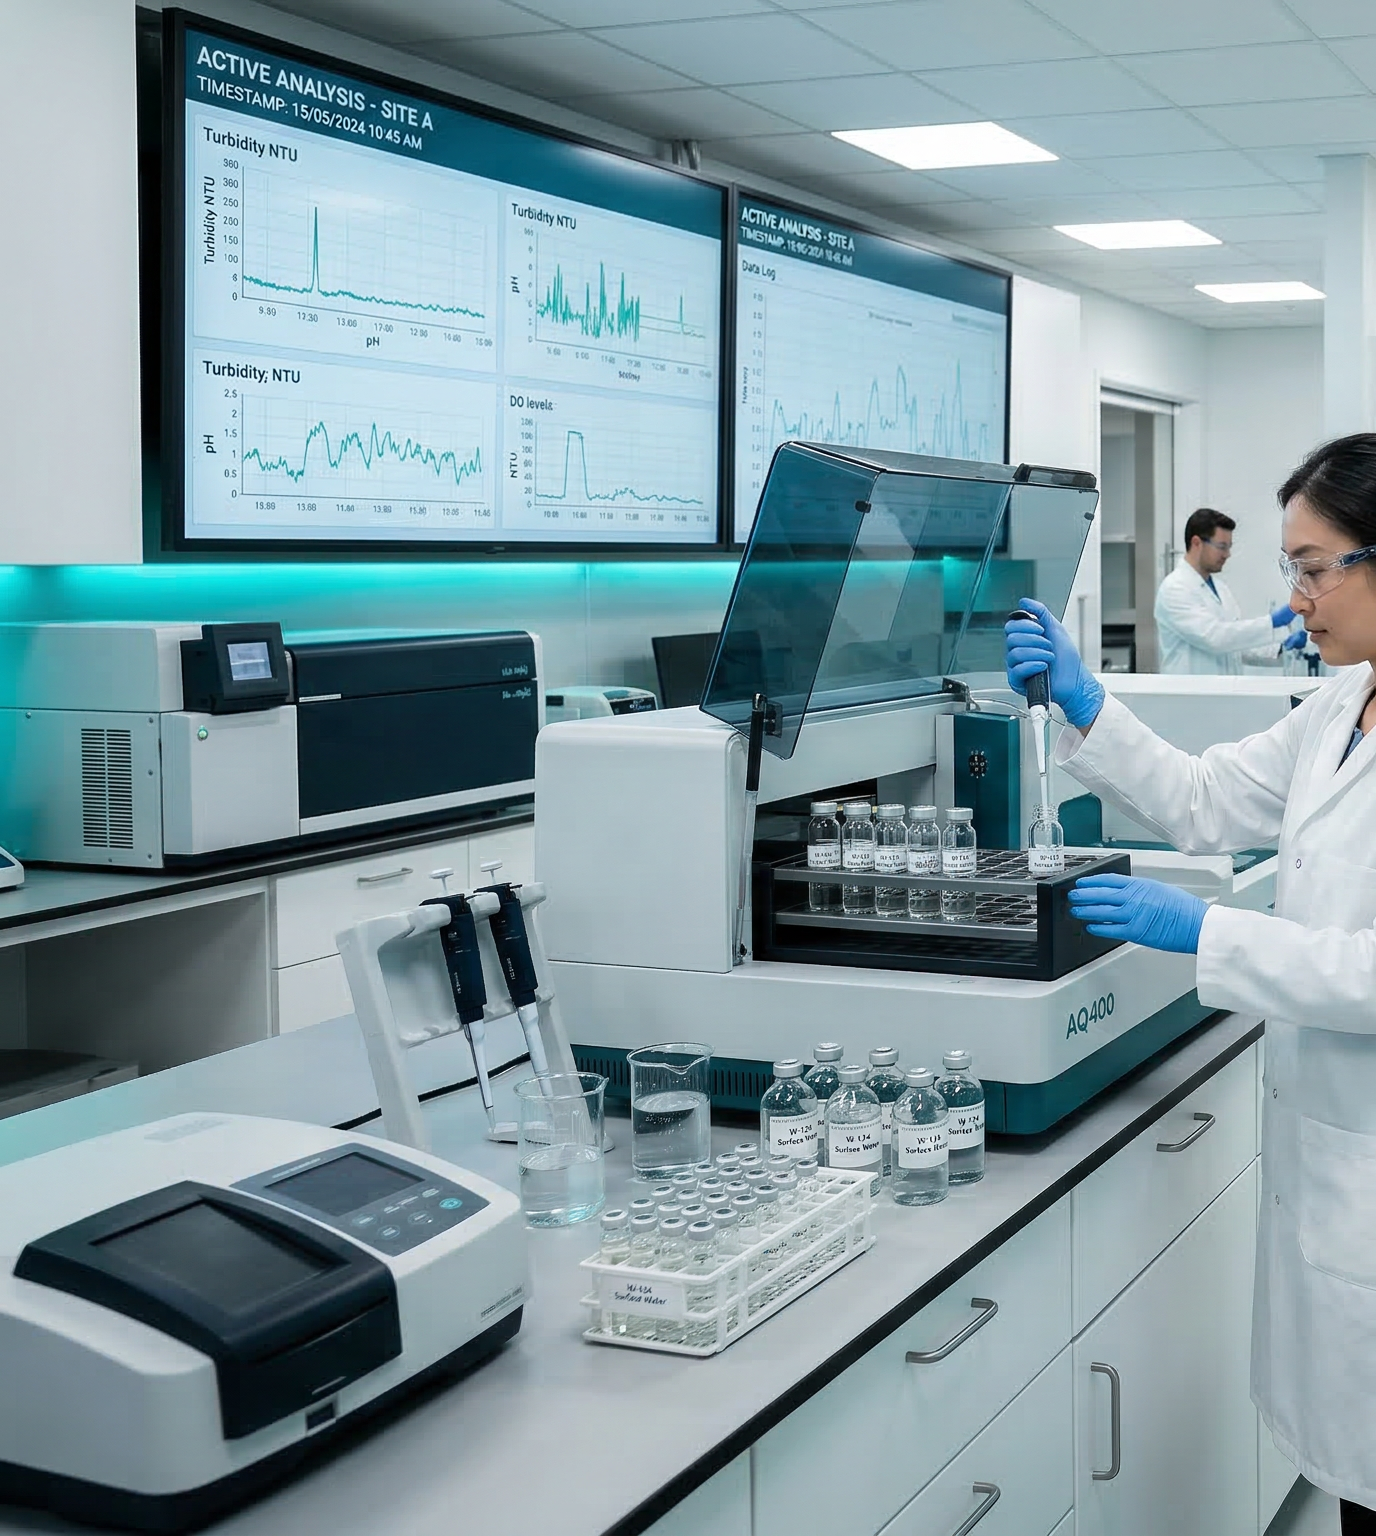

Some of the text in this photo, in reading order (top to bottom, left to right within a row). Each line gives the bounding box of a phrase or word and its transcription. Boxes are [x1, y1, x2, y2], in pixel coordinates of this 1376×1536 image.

[196, 46, 271, 85] ACTIVE
[276, 69, 366, 112] ANALYSIS
[381, 100, 418, 126] SITE
[422, 112, 433, 131] A
[196, 75, 288, 114] TIMESTAMP:
[292, 103, 366, 136] 15/05/2024
[403, 135, 423, 150] AM
[203, 127, 298, 162] Turbidity NTU
[204, 176, 215, 206] NTU
[223, 197, 239, 207] 250
[557, 214, 577, 230] NTU
[741, 207, 777, 229] ACTIVE
[848, 238, 856, 252] A
[223, 235, 239, 245] 150
[224, 254, 239, 263] 100
[762, 264, 776, 281] Log
[232, 293, 238, 301] 0
[366, 337, 380, 348] pH
[272, 368, 300, 384] NTU
[510, 395, 524, 408] DO
[232, 409, 237, 418] 2
[203, 434, 217, 454] pH
[232, 450, 236, 458] 1
[509, 452, 518, 478] NTU
[231, 490, 237, 498] 0
[1066, 992, 1115, 1040] AQ400
